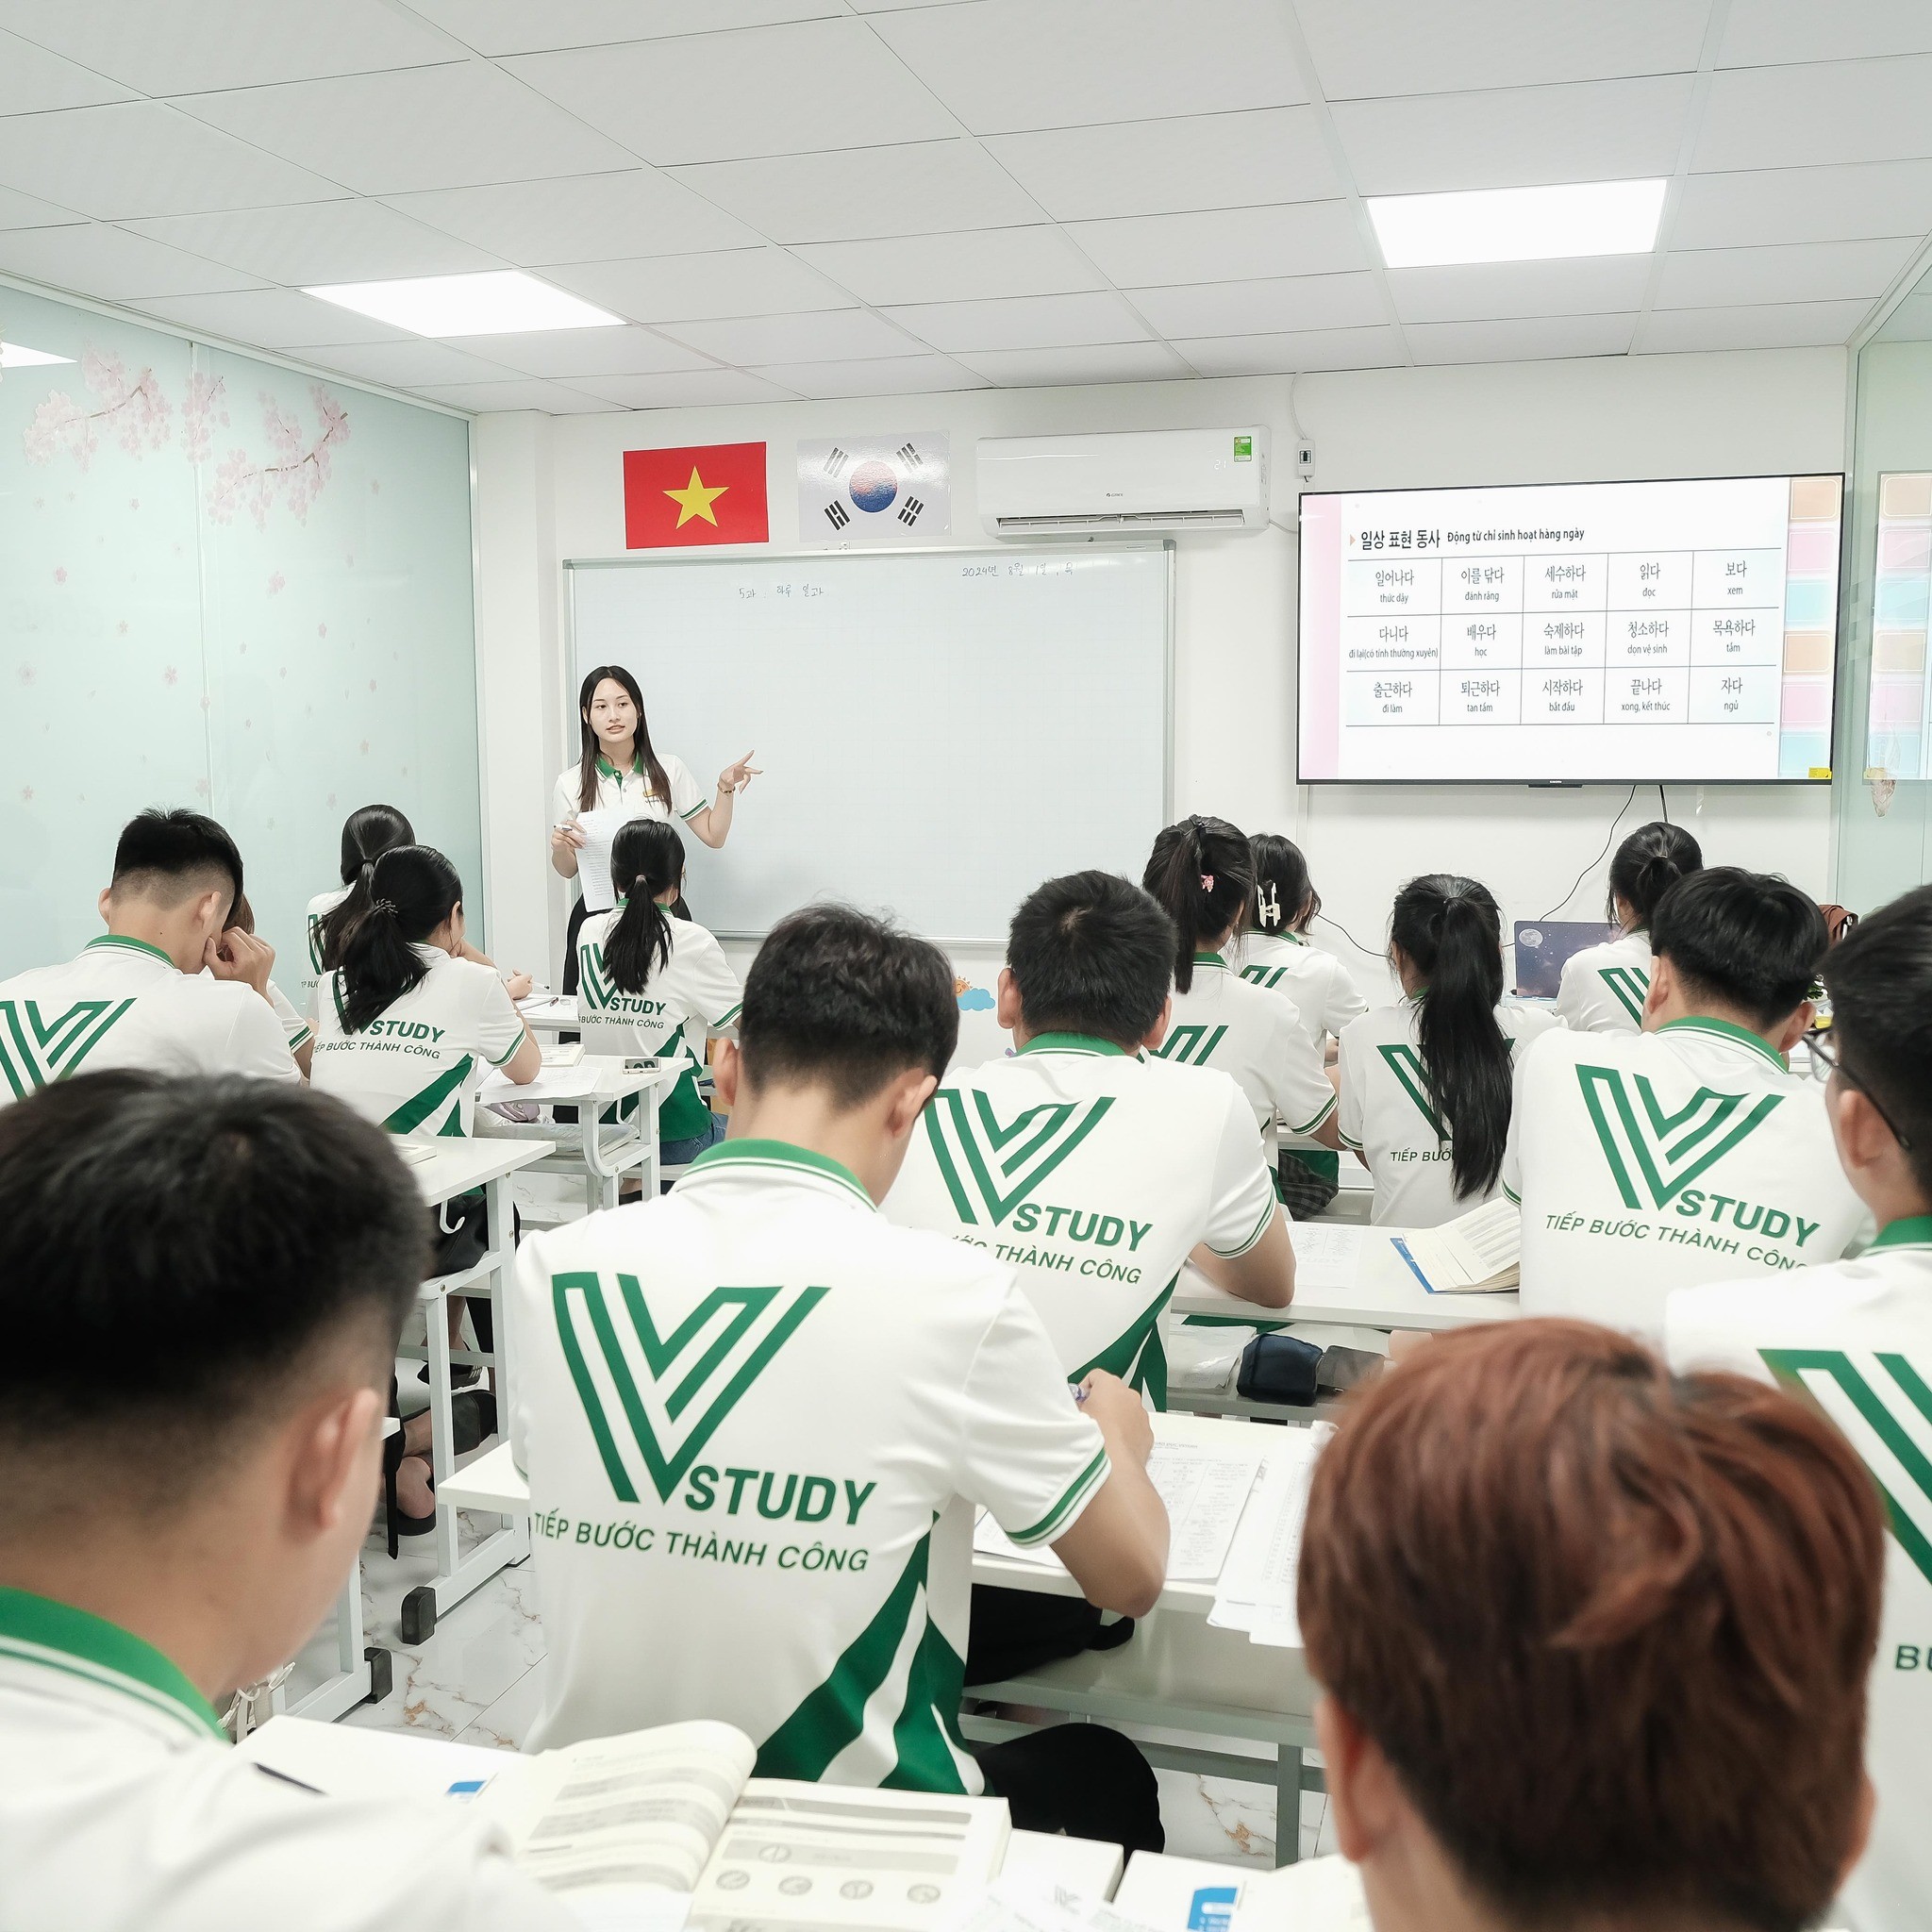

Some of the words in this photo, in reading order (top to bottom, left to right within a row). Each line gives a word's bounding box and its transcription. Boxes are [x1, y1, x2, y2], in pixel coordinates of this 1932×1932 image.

[1361, 530, 1385, 550] 일상
[1389, 530, 1411, 549] 표현
[1417, 529, 1440, 548] 동사
[1448, 531, 1470, 544] Động
[1473, 531, 1482, 541] từ
[1484, 529, 1495, 541] chỉ
[1498, 530, 1515, 541] sinh
[1518, 530, 1537, 541] hoạt
[1540, 528, 1560, 541] hàng
[1563, 528, 1584, 541] ngày
[1461, 568, 1481, 584] 이를
[1485, 567, 1504, 583] 닦다
[1545, 565, 1586, 582] 세수하다
[1641, 562, 1660, 580] 읽다
[1725, 560, 1747, 577] 보다
[1375, 569, 1414, 587] 일어나다
[1380, 593, 1394, 603] thức
[1465, 591, 1482, 600] đánh
[1642, 588, 1656, 598] đọc
[1379, 625, 1408, 642] 다니다
[1467, 625, 1496, 641] 배우다
[1544, 623, 1584, 639] 숙제하다
[1628, 621, 1669, 638] 청소하다
[1713, 619, 1756, 636] 목욕하다
[1475, 647, 1487, 658] học
[1545, 646, 1557, 655] làm
[1627, 644, 1641, 656] dọn
[1653, 644, 1667, 654] sinh
[1374, 681, 1412, 698] 출근하다
[1461, 680, 1500, 696] 퇴근하다
[1542, 679, 1583, 695] 시작하다
[1631, 678, 1662, 695] 끝나다
[1722, 677, 1742, 694] 자다
[1391, 704, 1402, 712] làm
[1622, 704, 1640, 713] xong,
[609, 997, 667, 1016] STUDY
[581, 1014, 602, 1024] BƯỚC
[605, 1016, 634, 1025] THÀNH
[637, 1019, 664, 1028] CÔNG
[370, 1020, 445, 1043] STUDY
[327, 1041, 357, 1051] BƯỚC
[360, 1041, 401, 1052] THÀNH
[404, 1043, 441, 1059] CÔNG
[1391, 1147, 1418, 1161] TIẾP
[1422, 1148, 1454, 1161] BƯỚ
[1012, 1203, 1154, 1252] STUDY
[1675, 1190, 1821, 1248] STUDY
[1545, 1211, 1585, 1232] TIẾP
[1589, 1218, 1651, 1240] BƯỚC
[1657, 1225, 1740, 1255] THÀNH
[994, 1243, 1074, 1273] THÀNH
[1079, 1258, 1142, 1285] CÔNG
[685, 1464, 878, 1525] STUDY
[535, 1507, 569, 1541] TIẾP
[575, 1520, 656, 1552] BƯỚC
[667, 1530, 768, 1567] THÀNH
[777, 1541, 870, 1572] CÔNG
